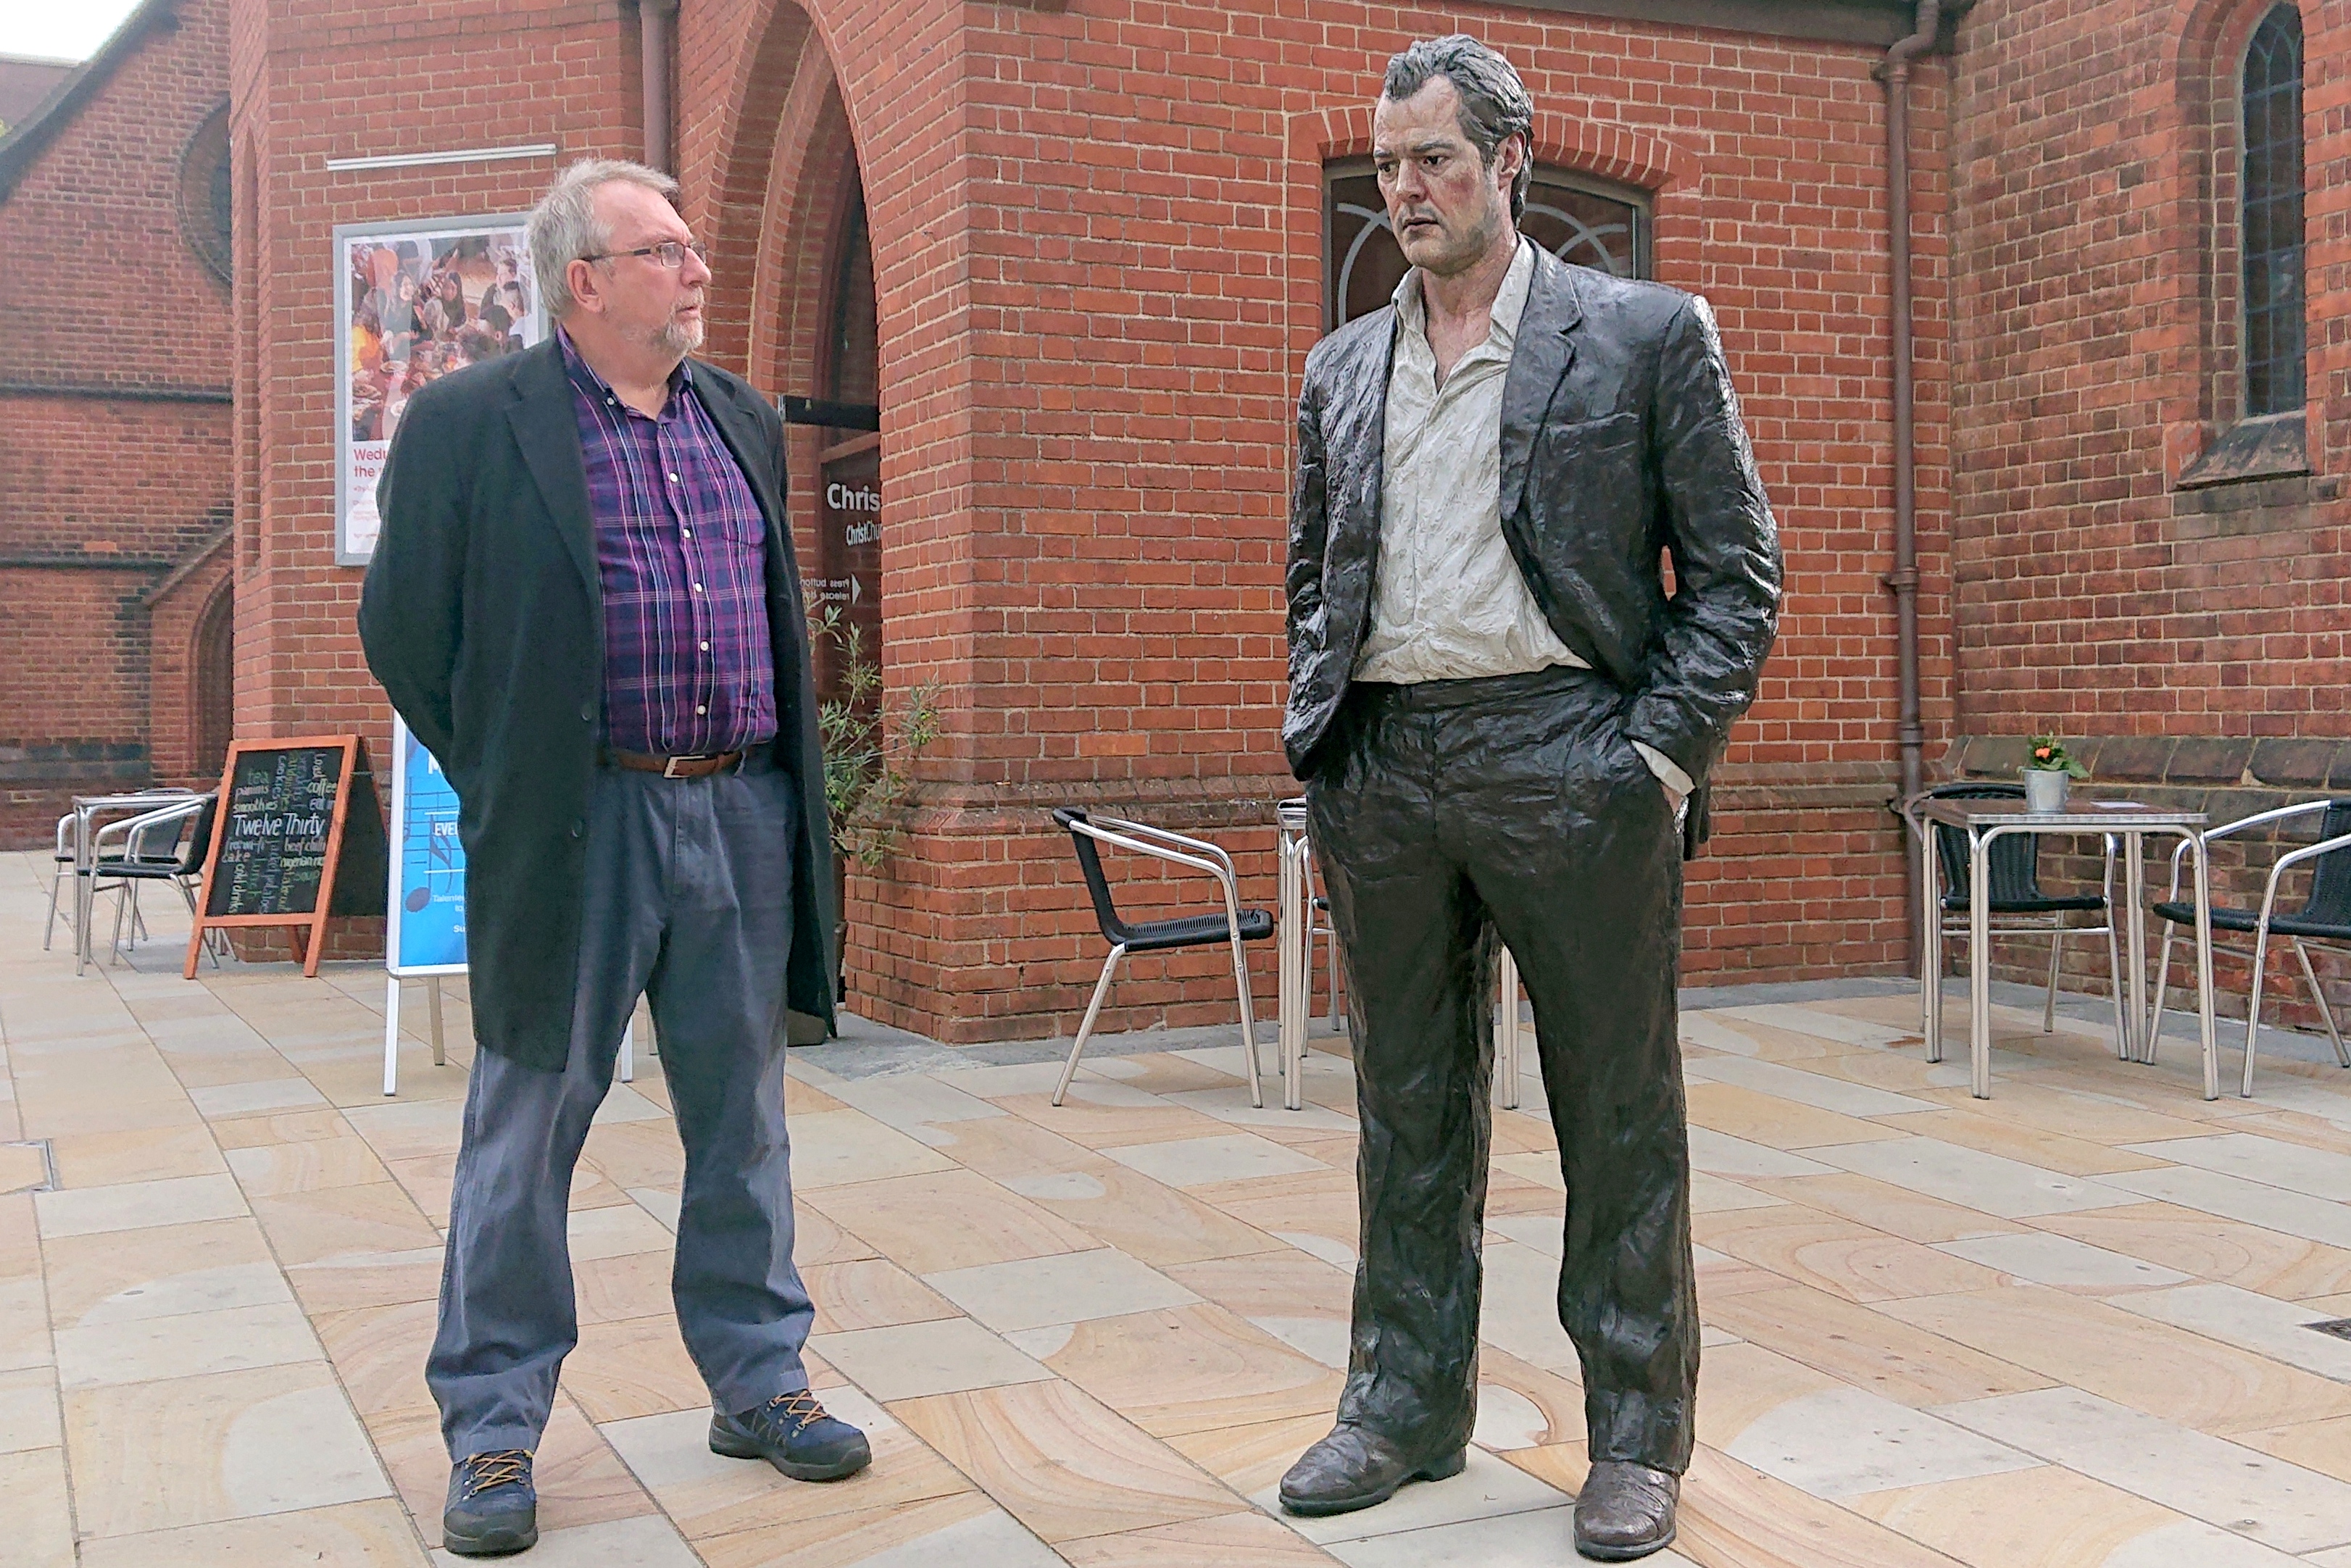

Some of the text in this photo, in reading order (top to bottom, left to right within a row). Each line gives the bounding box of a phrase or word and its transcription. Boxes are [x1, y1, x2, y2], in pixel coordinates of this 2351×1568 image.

[354, 465, 375, 478] the
[247, 768, 270, 785] tea
[272, 755, 287, 800] cookies
[306, 778, 337, 796] coffee
[232, 812, 325, 838] Twelve Thirty
[221, 850, 251, 863] cake
